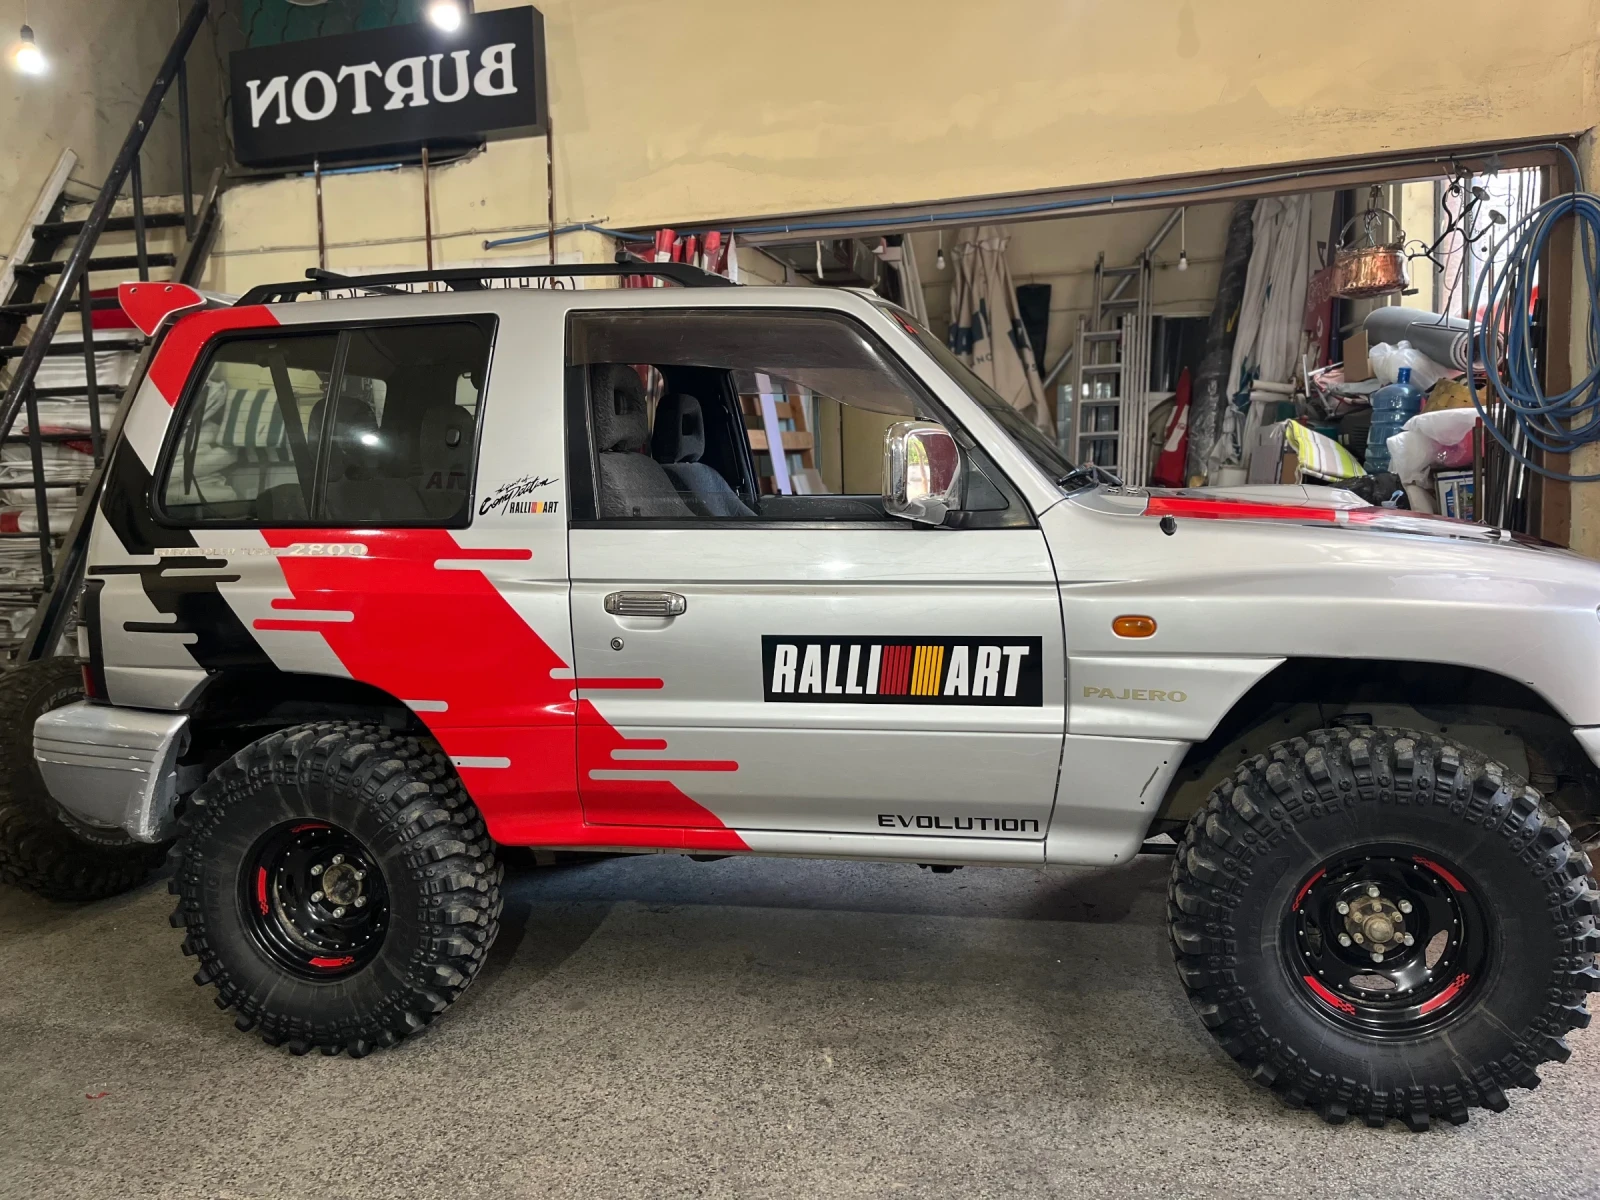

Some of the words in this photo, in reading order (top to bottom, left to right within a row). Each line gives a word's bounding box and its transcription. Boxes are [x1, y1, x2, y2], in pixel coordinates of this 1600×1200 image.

[288, 543, 369, 557] 2800
[1083, 686, 1188, 702] PAJERO
[877, 814, 1039, 834] EVOLUTION
